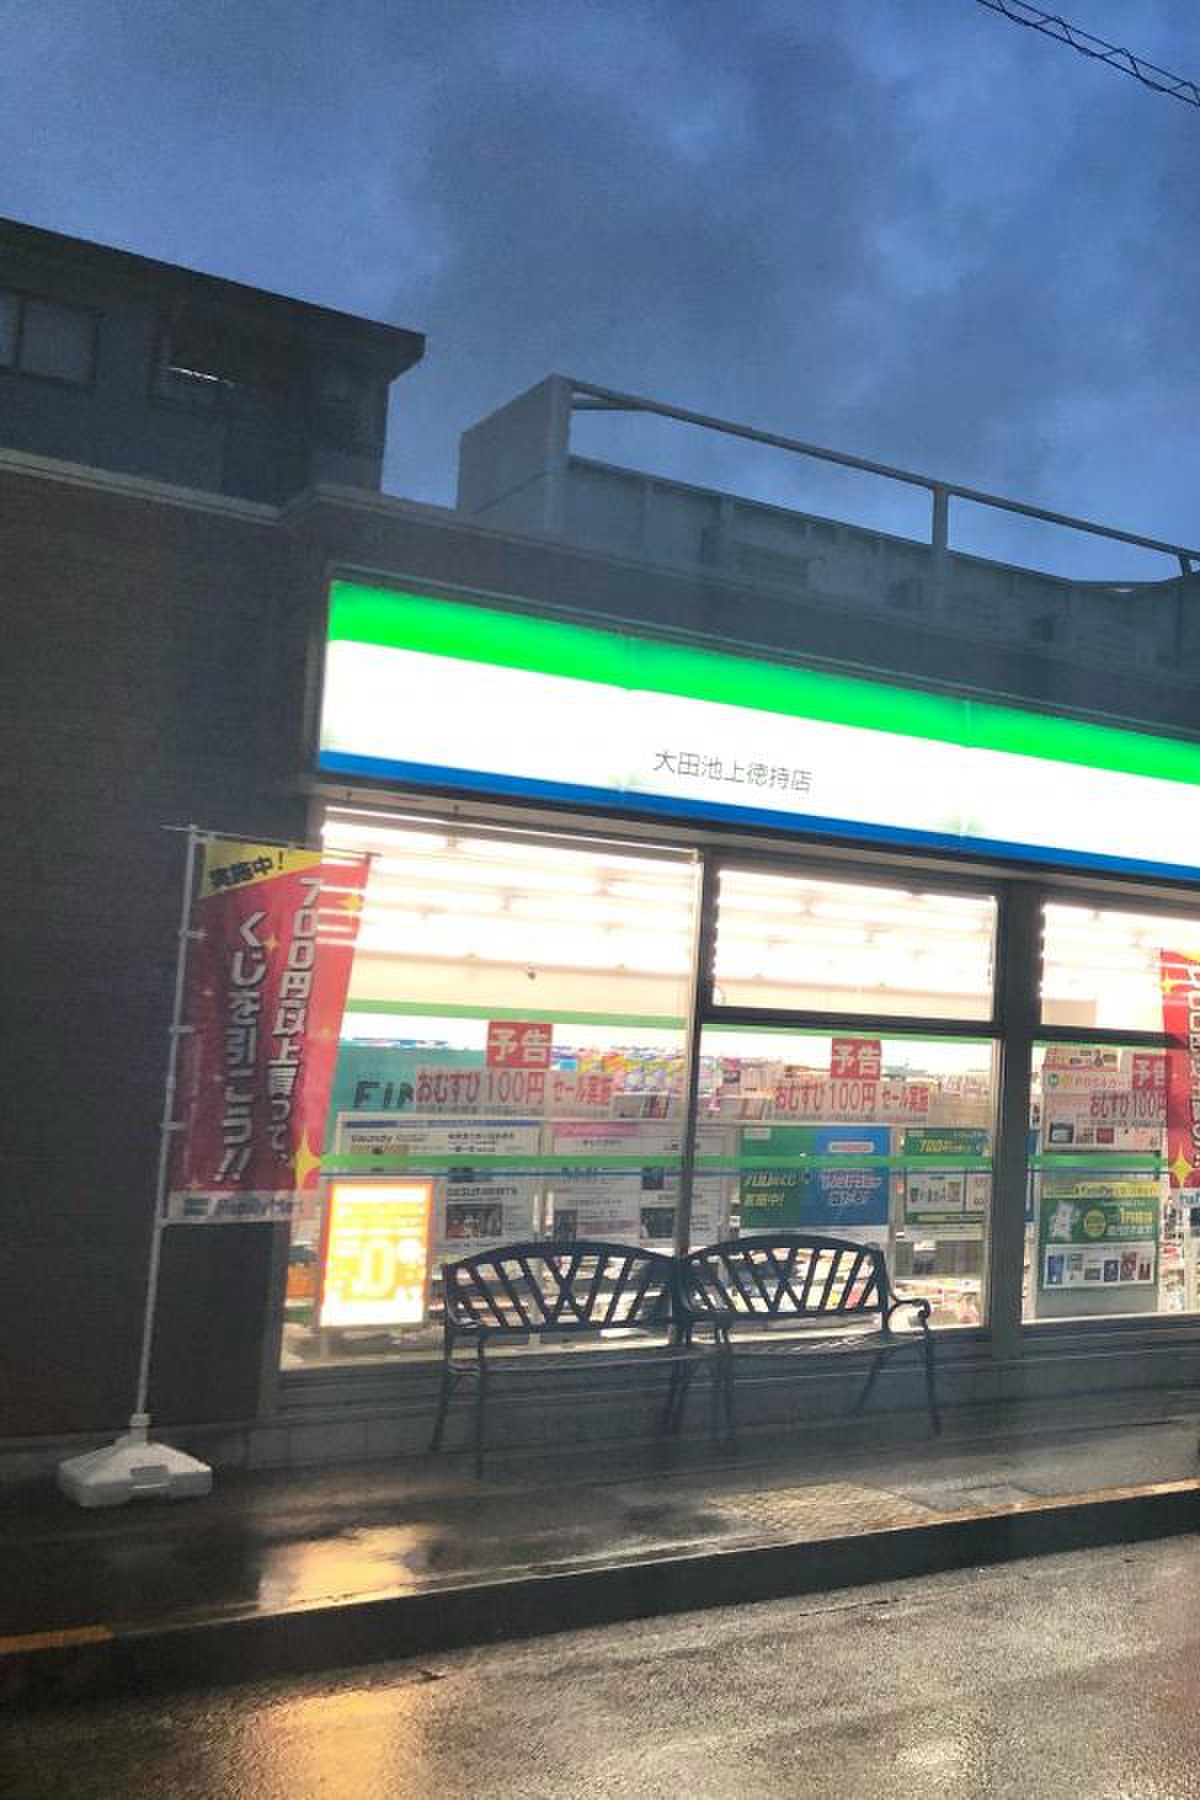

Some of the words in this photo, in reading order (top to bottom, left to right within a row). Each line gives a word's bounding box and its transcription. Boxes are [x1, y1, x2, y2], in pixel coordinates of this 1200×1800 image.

[653, 750, 813, 793] 大田池上徳持店
[488, 1028, 550, 1063] 予告
[832, 1044, 881, 1080] 予告
